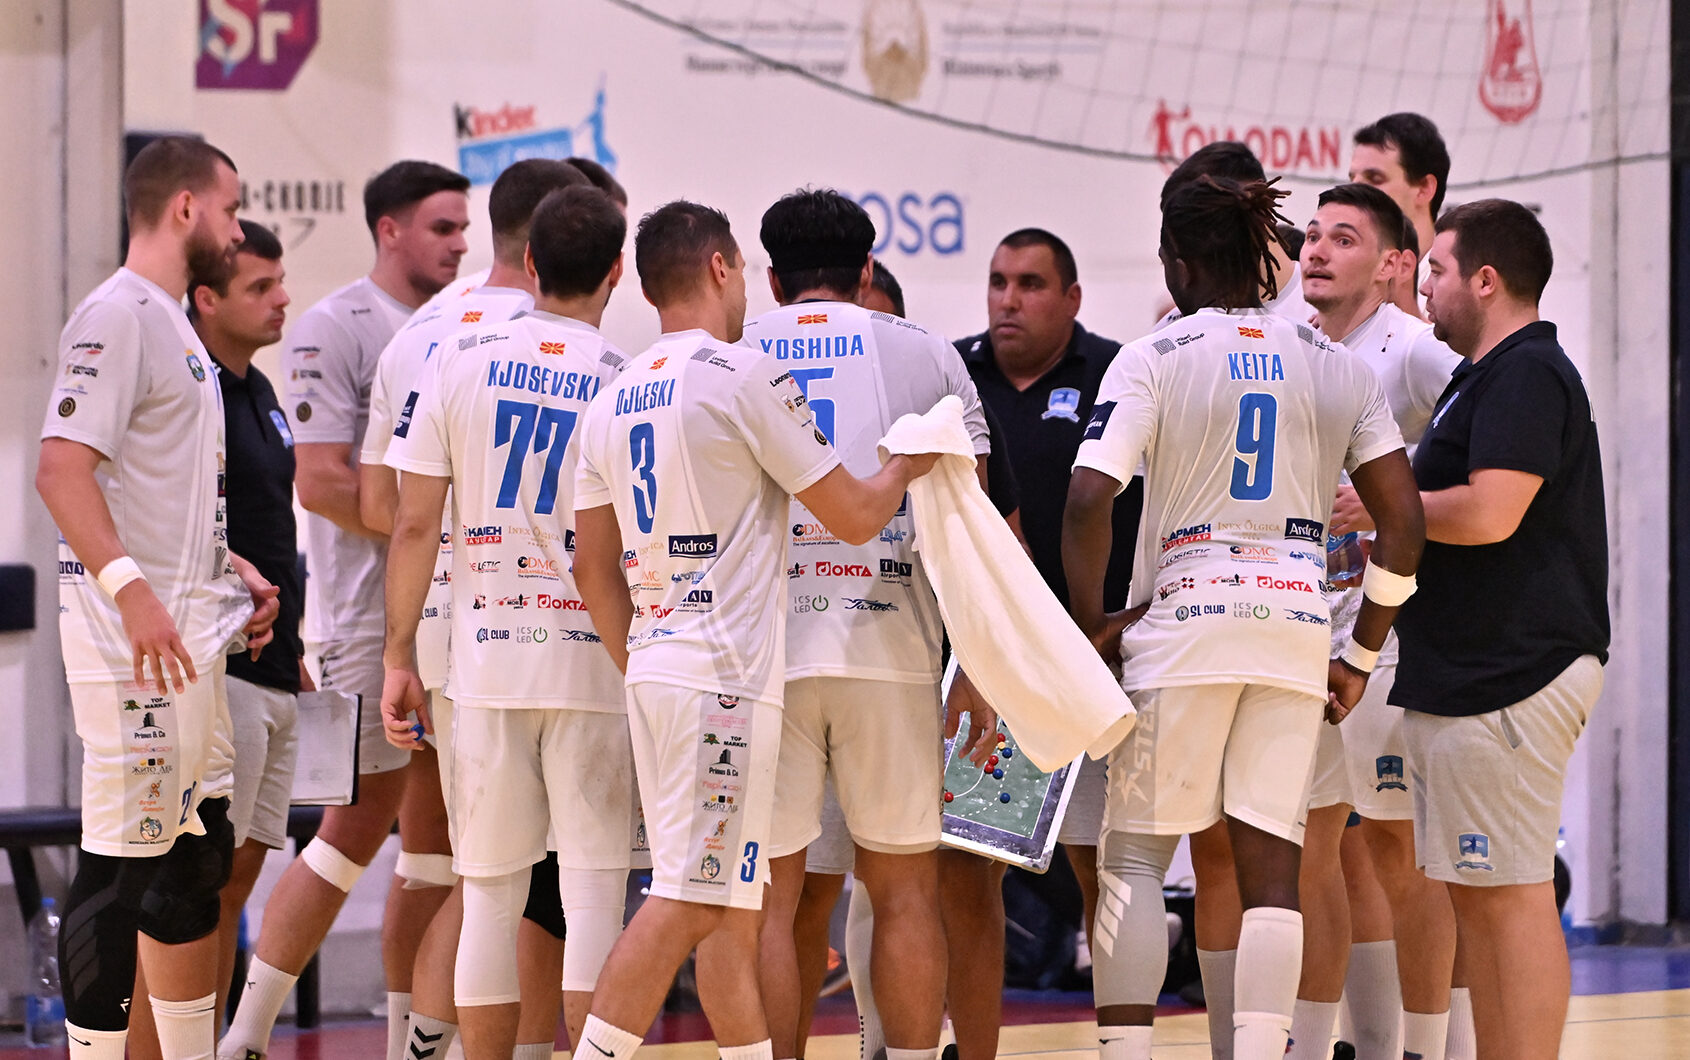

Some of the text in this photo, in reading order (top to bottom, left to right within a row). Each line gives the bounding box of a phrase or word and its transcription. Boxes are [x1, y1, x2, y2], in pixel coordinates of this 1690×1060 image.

[843, 191, 965, 254] osa
[760, 334, 864, 360] YOSHIDA
[1227, 352, 1285, 381] KEITA
[487, 360, 600, 402] KJOSEVSKI
[1229, 393, 1278, 501] 9
[494, 399, 578, 515] 77
[630, 422, 657, 534] 3
[804, 523, 829, 536] DM
[1289, 523, 1320, 537] Andro
[672, 540, 714, 552] Andros
[832, 565, 872, 577] OKTA
[1274, 580, 1313, 593] OKTA
[552, 598, 588, 610] OKTA
[794, 595, 811, 604] ICS
[795, 605, 811, 613] LED
[1204, 604, 1226, 614] CLUB
[1233, 602, 1251, 610] ICS
[1234, 610, 1251, 618] LED
[491, 629, 510, 640] CLUB
[516, 626, 532, 635] ICS
[516, 635, 532, 644] LED
[724, 740, 748, 748] MARKET
[740, 840, 759, 883] 3
